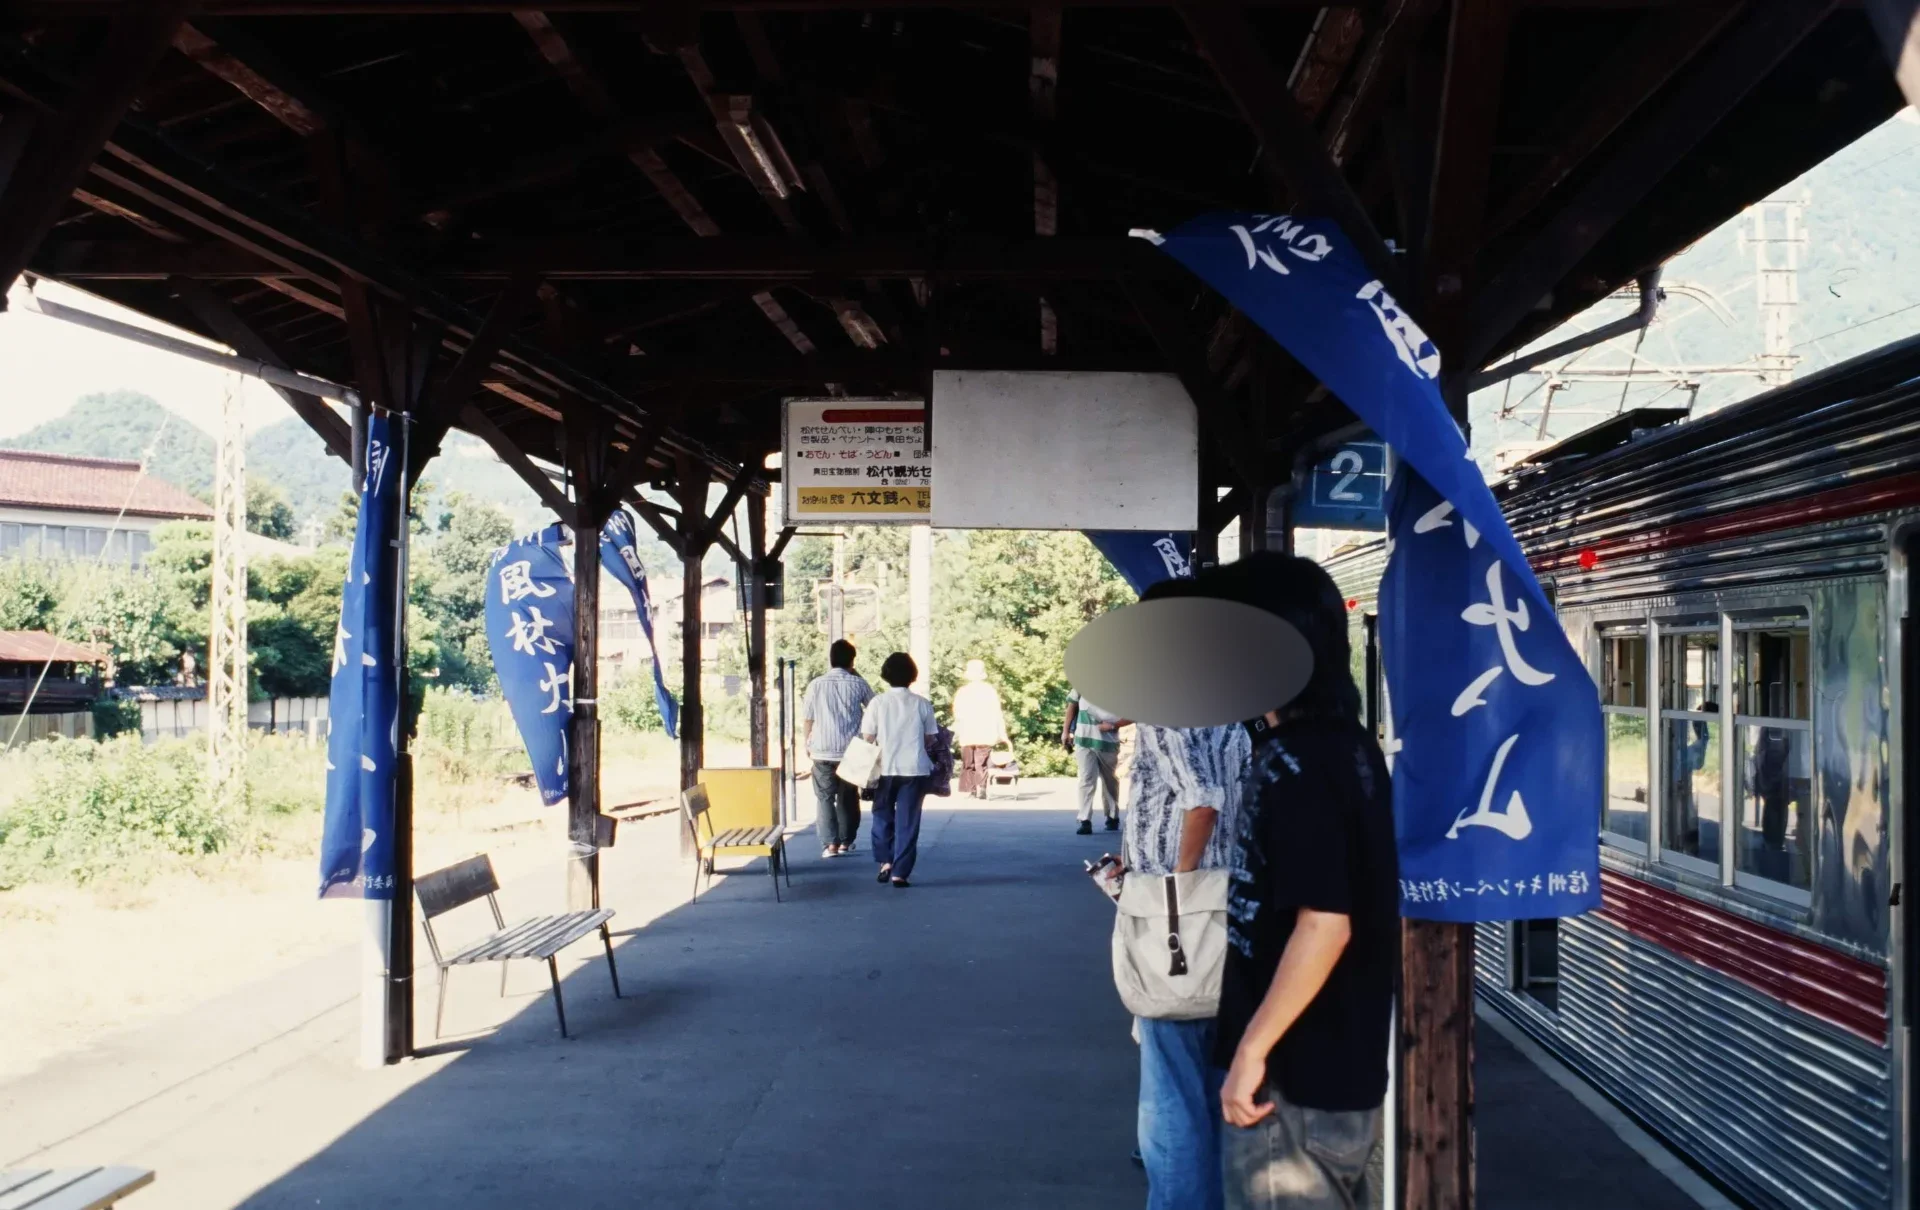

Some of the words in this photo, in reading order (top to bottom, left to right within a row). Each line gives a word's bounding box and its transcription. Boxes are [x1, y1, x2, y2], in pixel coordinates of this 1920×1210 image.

[1328, 450, 1364, 502] 2
[498, 559, 575, 776] 風林火
